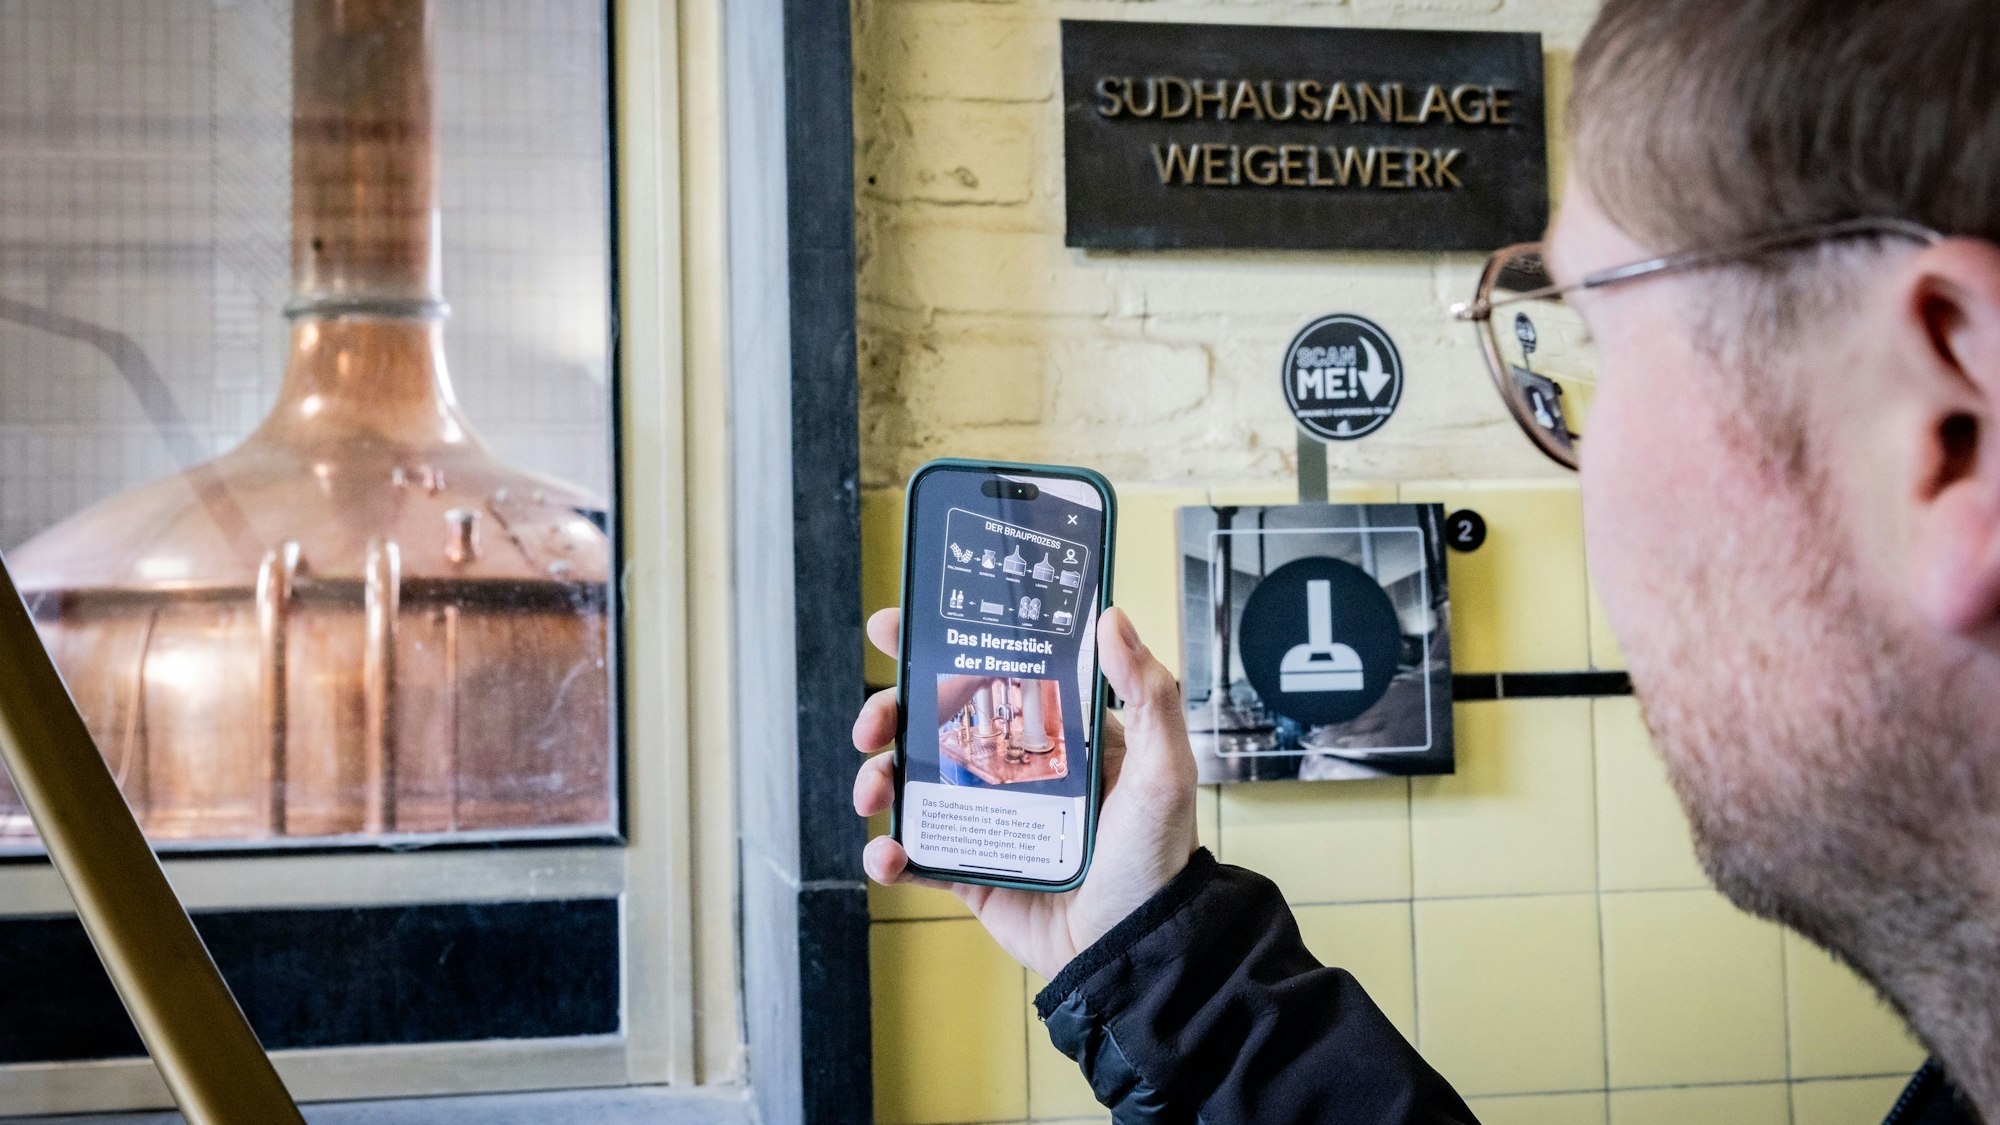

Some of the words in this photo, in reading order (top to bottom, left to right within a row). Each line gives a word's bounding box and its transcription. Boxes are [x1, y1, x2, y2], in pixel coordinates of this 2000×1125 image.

[1096, 75, 1512, 126] SUDHAUSANLAGE
[1151, 142, 1465, 189] WEIGELWERK
[1296, 345, 1357, 368] SCAN
[1296, 366, 1358, 400] ME!
[985, 521, 1003, 534] DER
[1004, 527, 1061, 549] BRAUPROZESS
[1456, 519, 1474, 542] 2
[947, 628, 978, 647] Das
[981, 633, 1053, 655] Herzstück
[954, 653, 982, 670] der
[985, 655, 1046, 674] Brauerei
[922, 798, 937, 808] Das
[939, 800, 974, 811] Sudhaus
[975, 804, 988, 813] mit
[990, 806, 1017, 816] seinen
[921, 809, 980, 823] Kupferkesseln
[981, 816, 992, 824] ist
[995, 818, 1011, 827] das
[1011, 820, 1030, 829] Herz
[1031, 821, 1046, 830] der
[920, 831, 982, 846] Bierherstellung
[984, 838, 1016, 849] beginnt.
[1019, 843, 1036, 851] Hier
[959, 824, 967, 832] in
[968, 826, 986, 835] dem
[988, 828, 1001, 836] der
[1003, 829, 1036, 840] Prozess
[1037, 832, 1051, 842] der
[920, 843, 940, 852] kann
[941, 846, 959, 854] man
[960, 847, 977, 856] sich
[979, 849, 998, 858] auch
[1000, 852, 1017, 860] sein
[1018, 854, 1051, 864] eigenes
